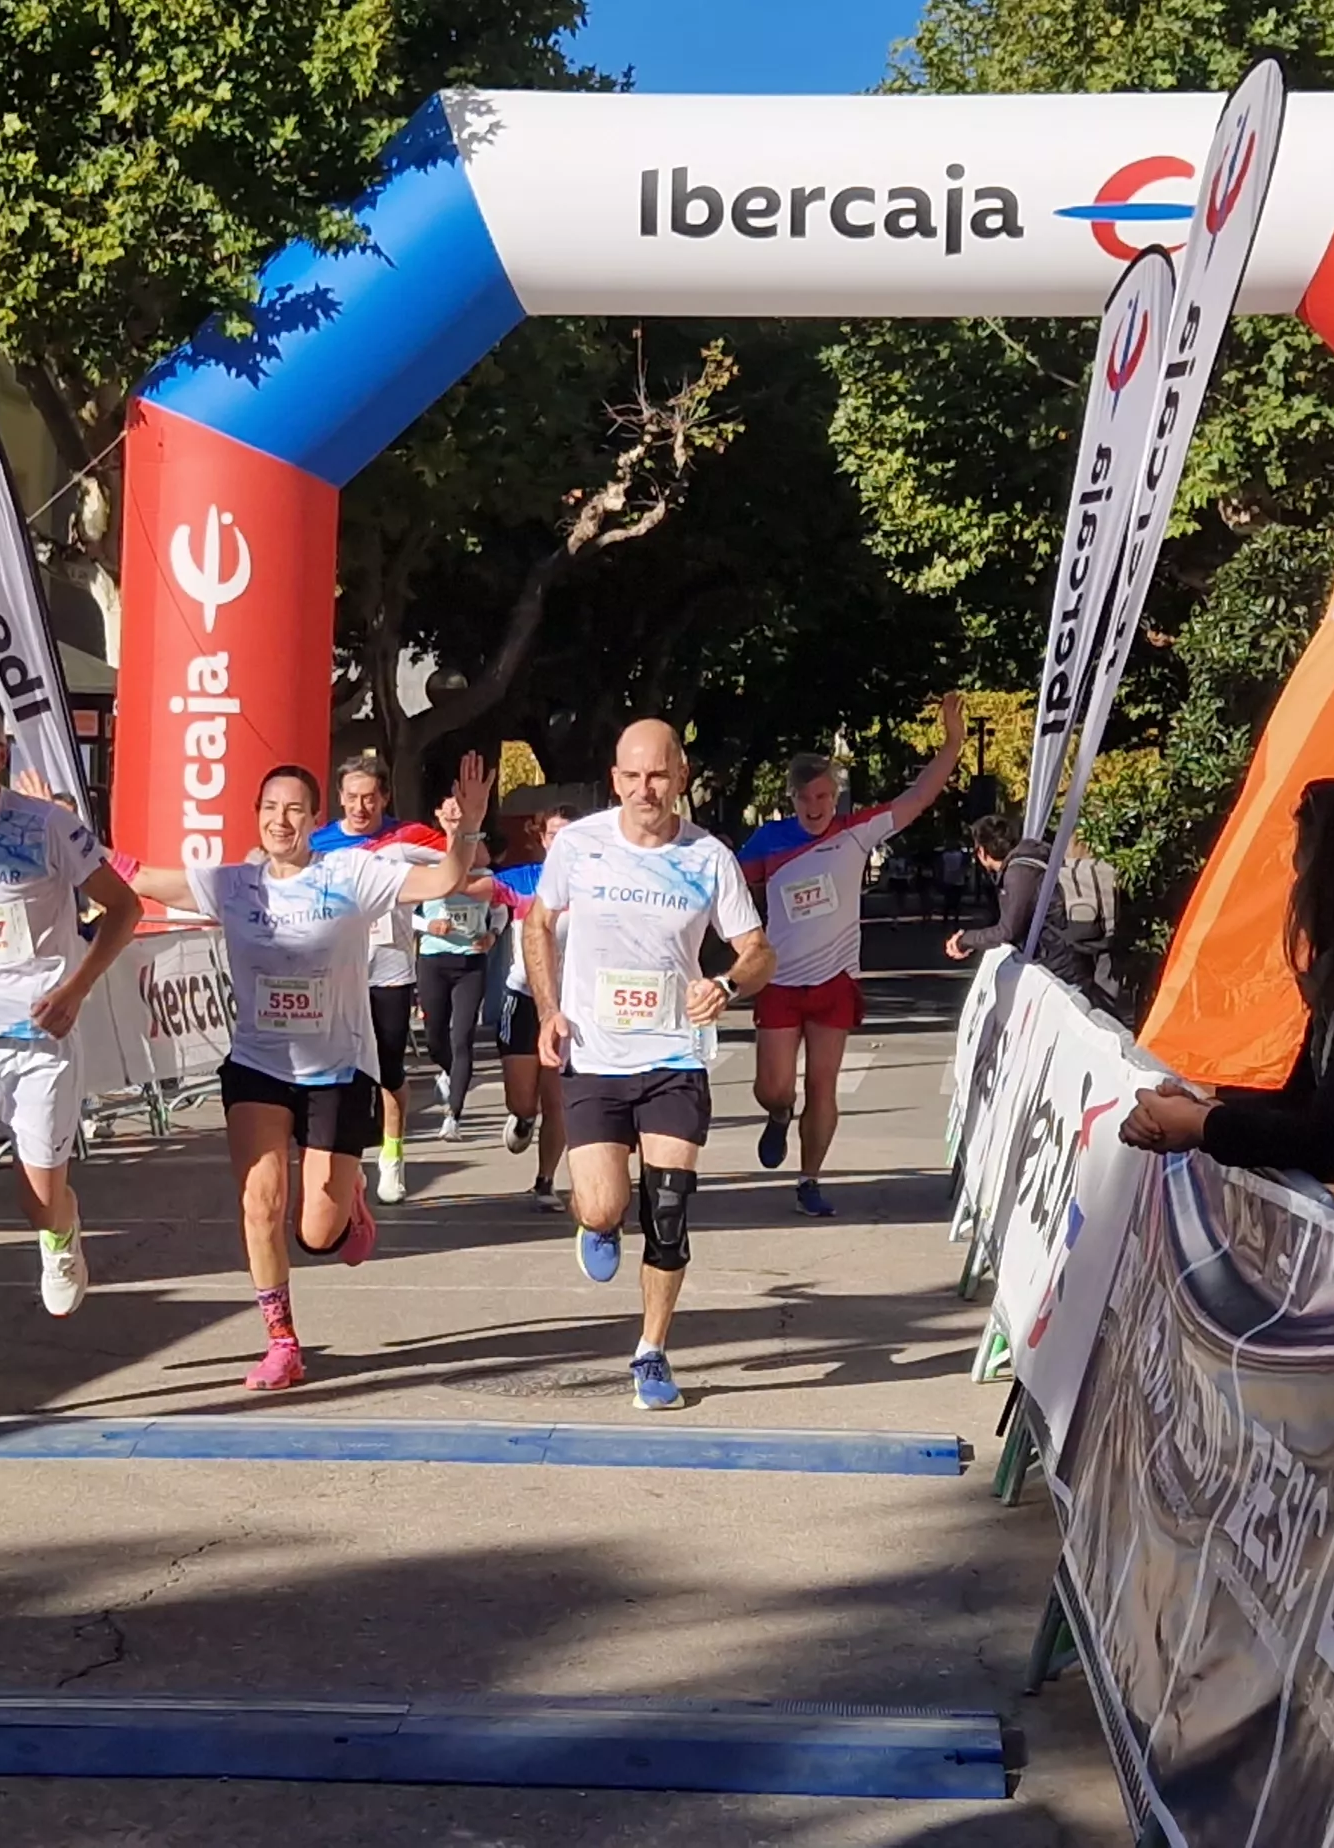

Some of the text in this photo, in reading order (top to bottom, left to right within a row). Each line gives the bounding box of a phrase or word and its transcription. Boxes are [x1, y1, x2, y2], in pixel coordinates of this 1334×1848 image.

[640, 163, 1024, 256] Ibercaja
[608, 886, 689, 912] COGITIAR
[794, 886, 821, 904] 577
[269, 992, 311, 1010] 559
[613, 989, 658, 1008] 558
